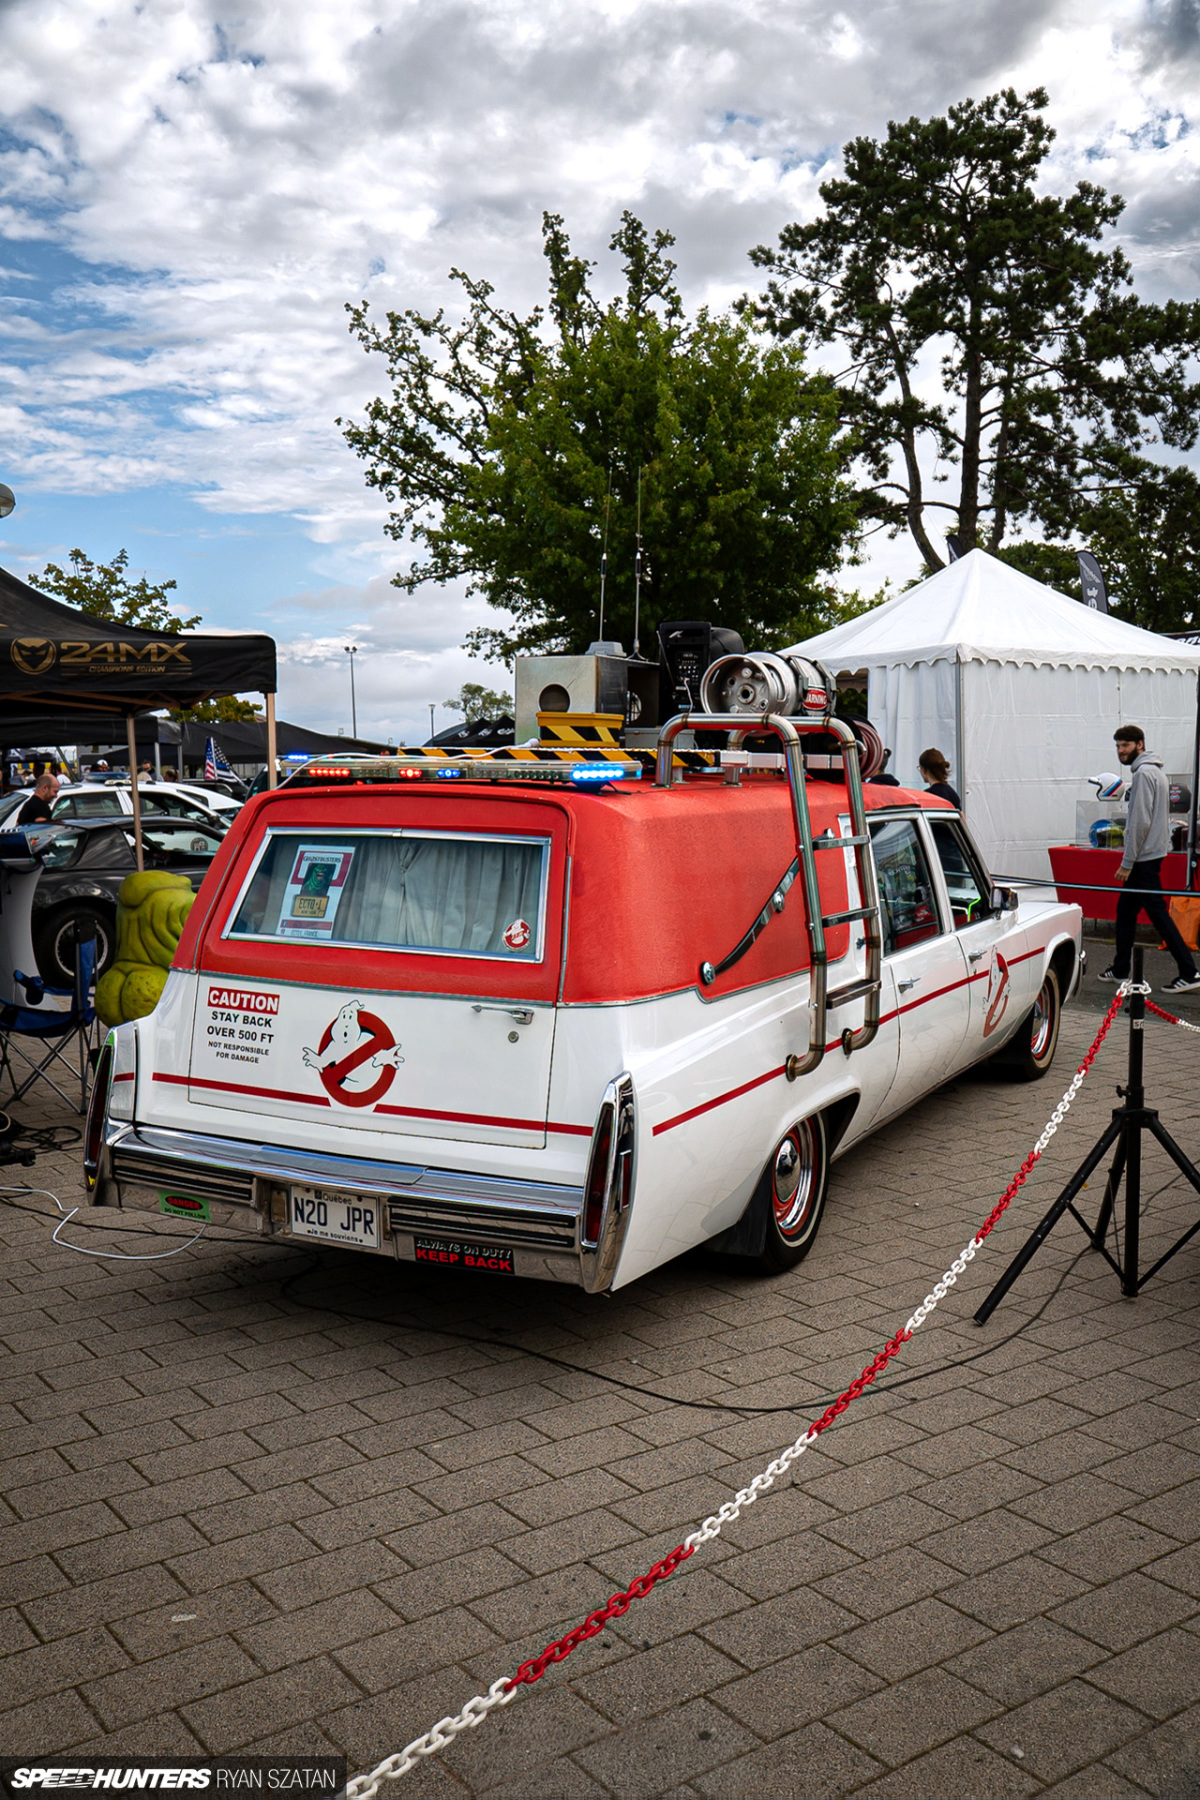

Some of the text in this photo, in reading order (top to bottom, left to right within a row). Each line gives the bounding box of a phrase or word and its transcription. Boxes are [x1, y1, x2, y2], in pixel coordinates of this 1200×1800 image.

[60, 642, 191, 662] 24MX
[88, 665, 165, 673] CHAMPIONS EDITION
[303, 855, 342, 863] GHOSTBUSTERS
[209, 990, 278, 1012] CAUTION
[211, 1010, 272, 1028] STAY BACK
[207, 1025, 274, 1043] OVER 500 FT
[208, 1040, 269, 1056] NOT RESPONSIBLE
[216, 1051, 259, 1064] FOR DAMAGE
[167, 1197, 200, 1210] DANGER
[322, 1193, 353, 1205] Québec
[184, 1211, 206, 1220] FOLLOW
[340, 1206, 374, 1235] JPR
[330, 1231, 358, 1243] souviens
[416, 1238, 461, 1253] ALWAYS
[463, 1245, 479, 1255] ON
[416, 1248, 512, 1271] KEEP BACK
